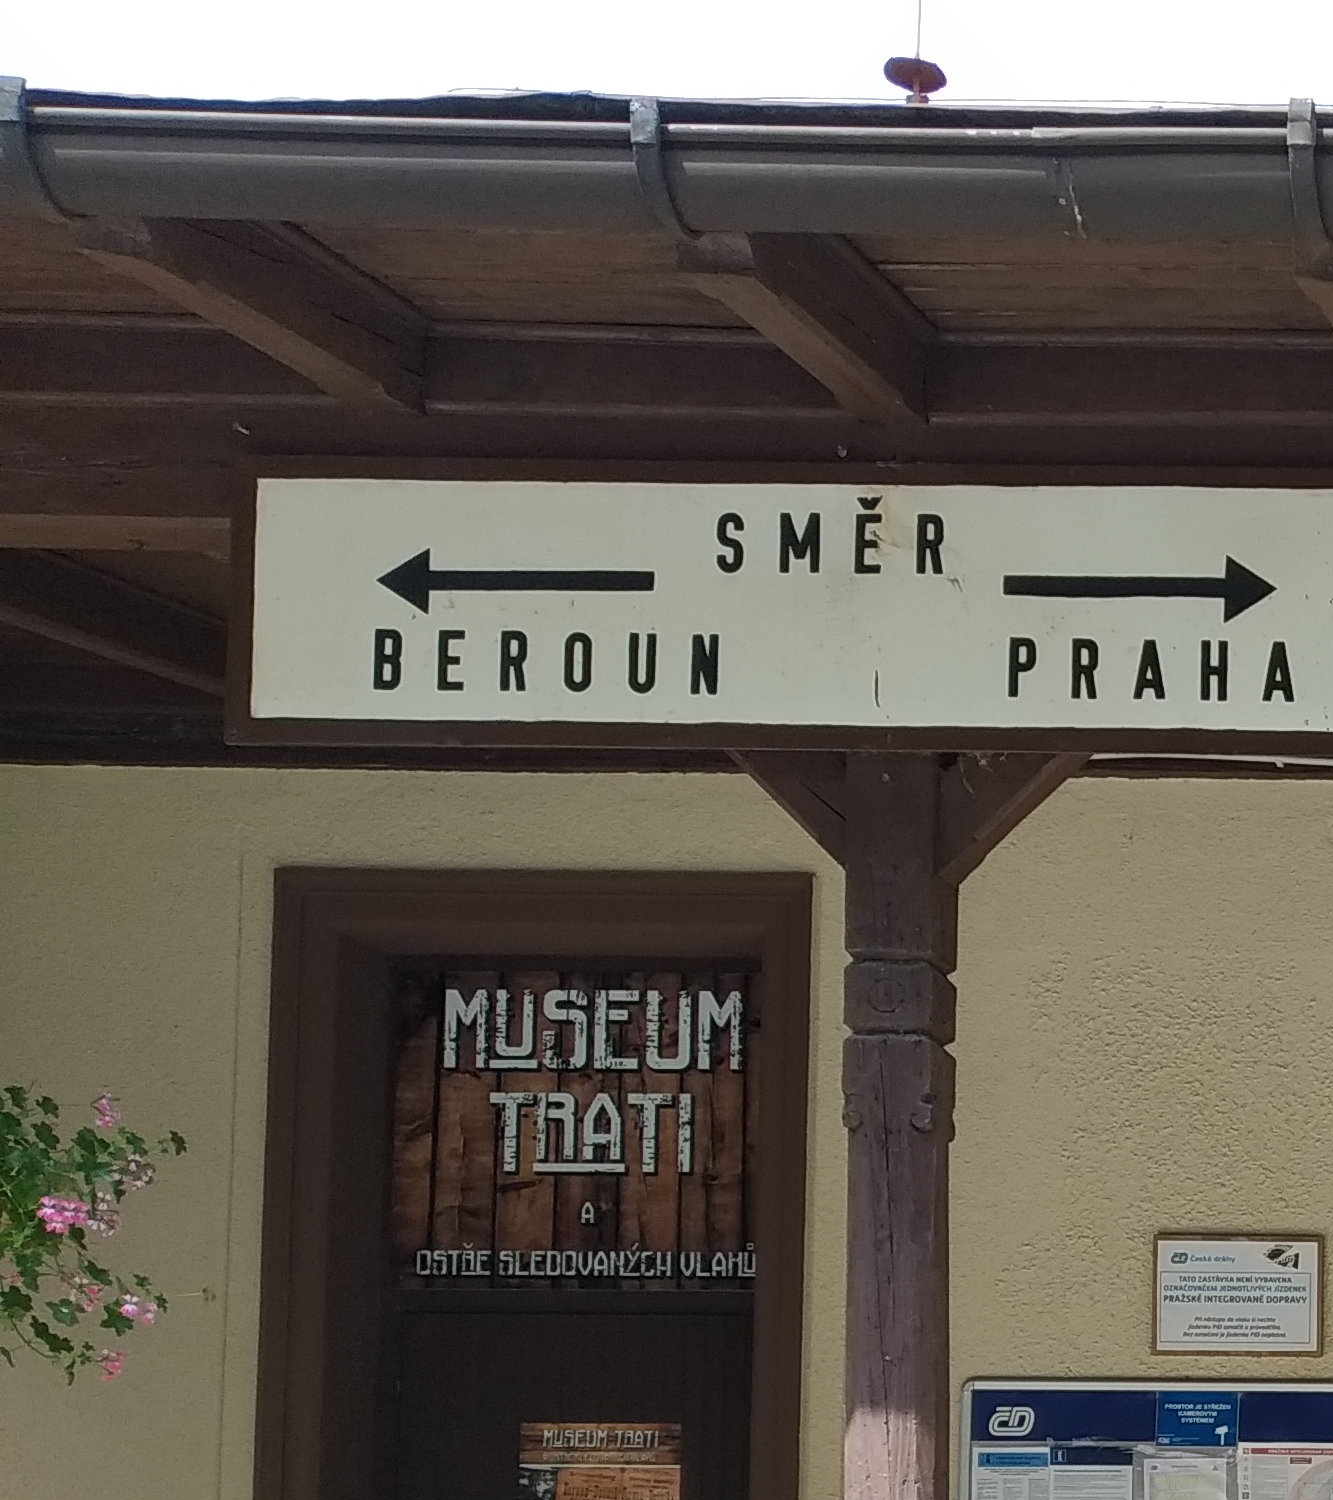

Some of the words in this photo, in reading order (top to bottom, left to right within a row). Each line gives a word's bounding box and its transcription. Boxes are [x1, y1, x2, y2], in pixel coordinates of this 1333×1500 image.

[716, 497, 946, 576] SMĚR
[373, 628, 720, 696] BEROUN
[1007, 636, 1296, 704] PRAHA
[443, 987, 744, 1071] MUSEUM
[489, 1091, 694, 1174] TRATI
[580, 1201, 596, 1224] A
[1163, 1293, 1202, 1303] PRAŽSKÉ
[1204, 1294, 1265, 1304] INTEGROVANÉ
[1266, 1296, 1308, 1304] DOPRAVY
[542, 1429, 608, 1448] MUSEUM
